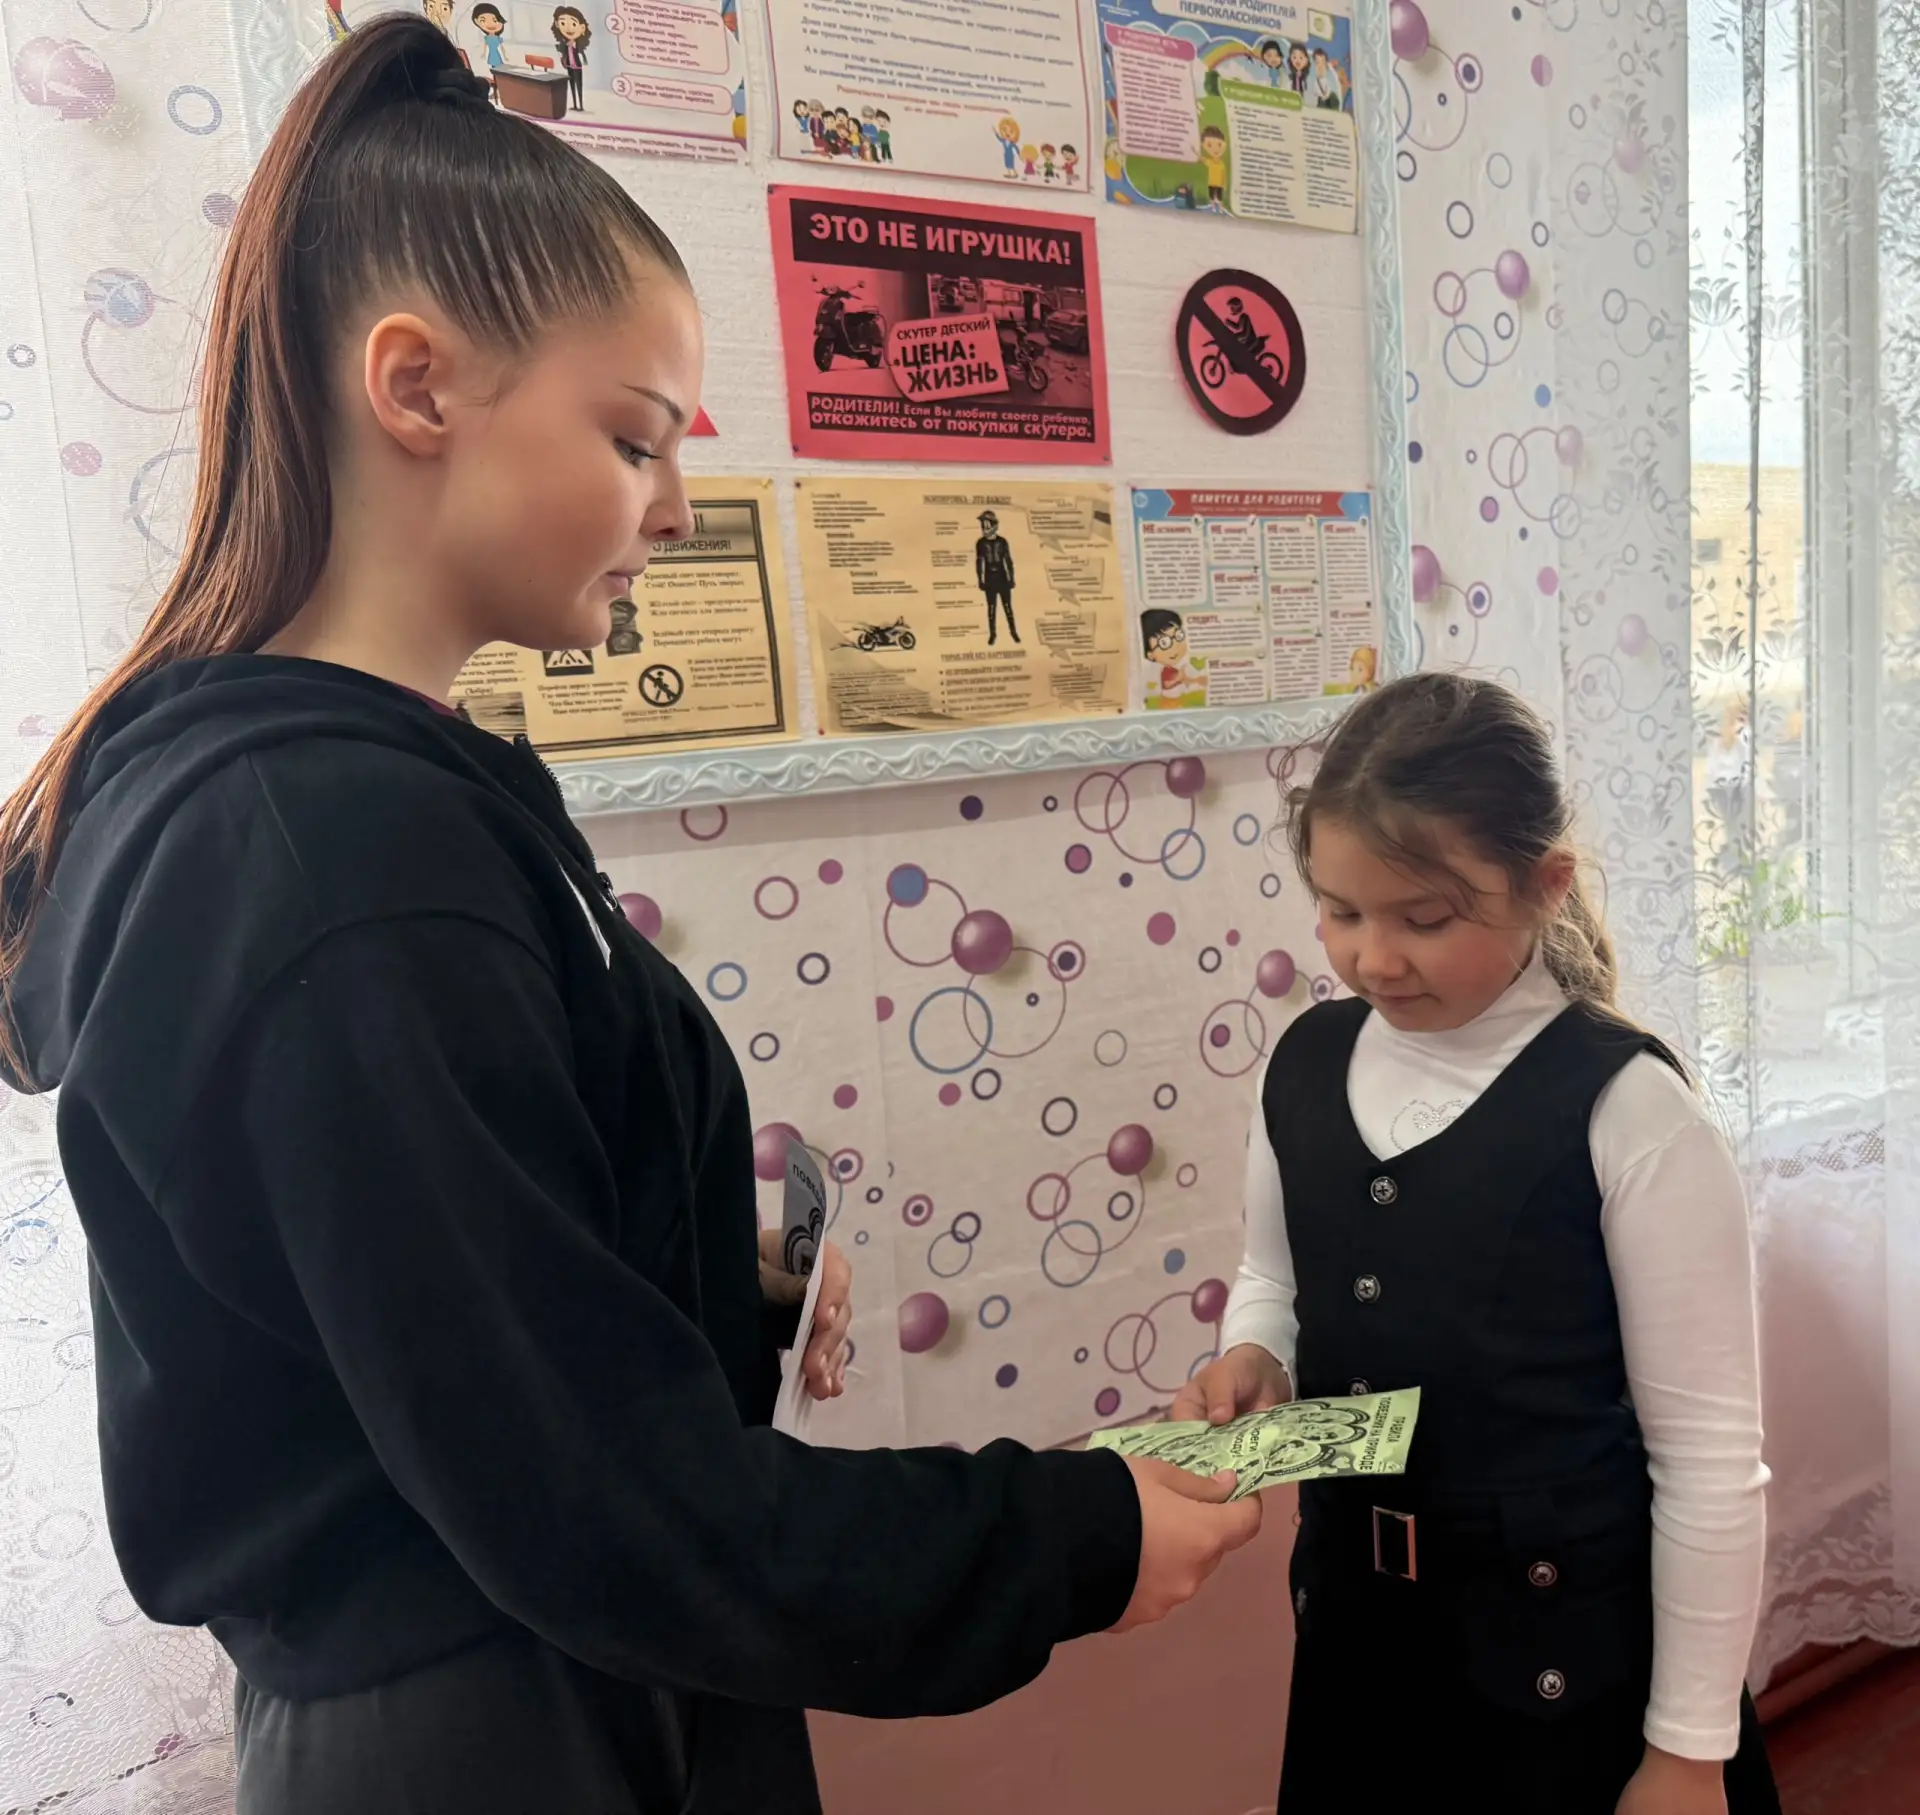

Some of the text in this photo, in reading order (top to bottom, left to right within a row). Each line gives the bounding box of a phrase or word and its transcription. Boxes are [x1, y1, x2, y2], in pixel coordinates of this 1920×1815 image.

[610, 18, 620, 31] 2
[1180, 1, 1281, 29] ПЕРВОКЛАССНИКОВ
[616, 79, 626, 94] 3
[809, 213, 1072, 265] ЭТО НЕ ИГРУШКА!
[896, 316, 990, 340] СКУТЕР ДЕТСКИЙ
[902, 340, 976, 370] ЦЕНА:
[907, 362, 999, 394] ЖИЗНЬ
[811, 396, 900, 414] РОДИТЕЛИ!
[904, 404, 931, 416] Если
[934, 406, 952, 418] Вы
[955, 408, 998, 420] любите
[1002, 412, 1039, 422] своего
[811, 411, 1092, 440] откажитесь от покупки скутера.
[1190, 493, 1322, 506] ПАМЯТКА ДЛЯ РОДИТЕЛЕЙ
[664, 540, 732, 553] ДВИЖЕНИЯ!
[1370, 1429, 1382, 1437] НА
[1386, 1416, 1406, 1443] ПРАВИЛА
[1359, 1438, 1380, 1470] ПРИРОДЕ
